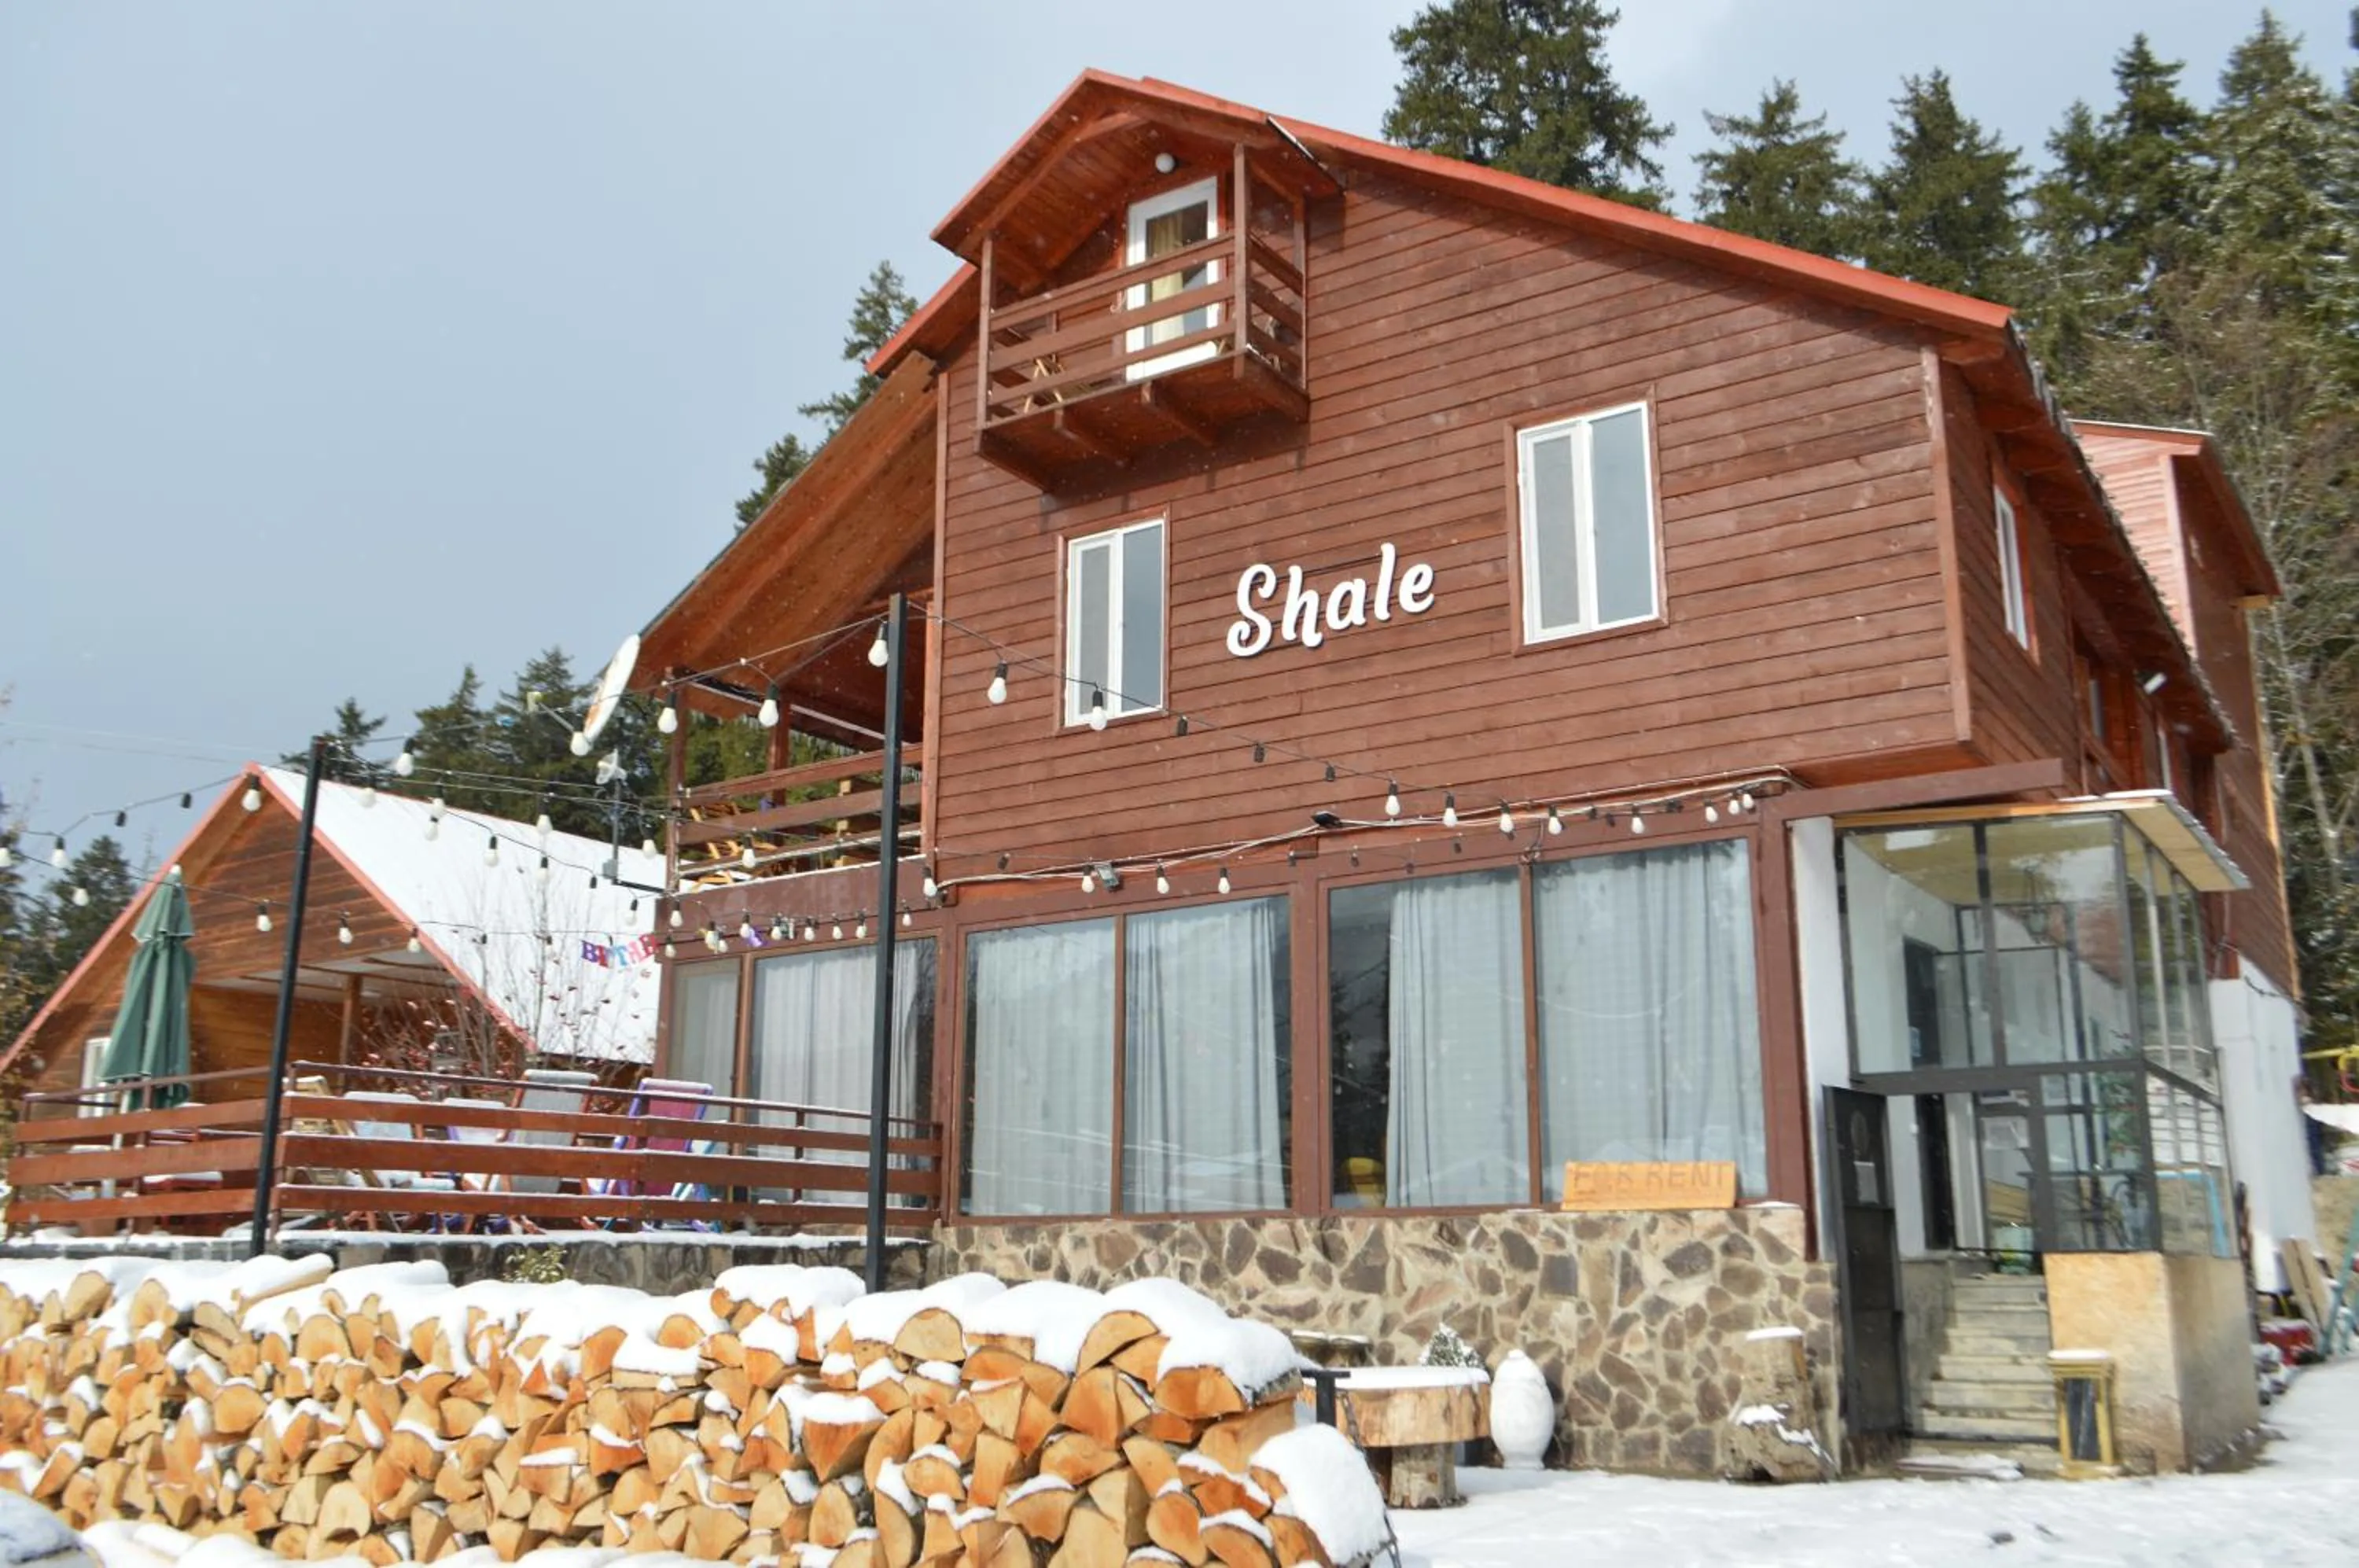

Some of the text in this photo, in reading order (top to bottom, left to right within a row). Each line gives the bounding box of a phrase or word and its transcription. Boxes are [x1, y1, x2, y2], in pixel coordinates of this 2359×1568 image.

[1226, 542, 1435, 657] Shale
[1573, 1161, 1731, 1190] FOR RENT
